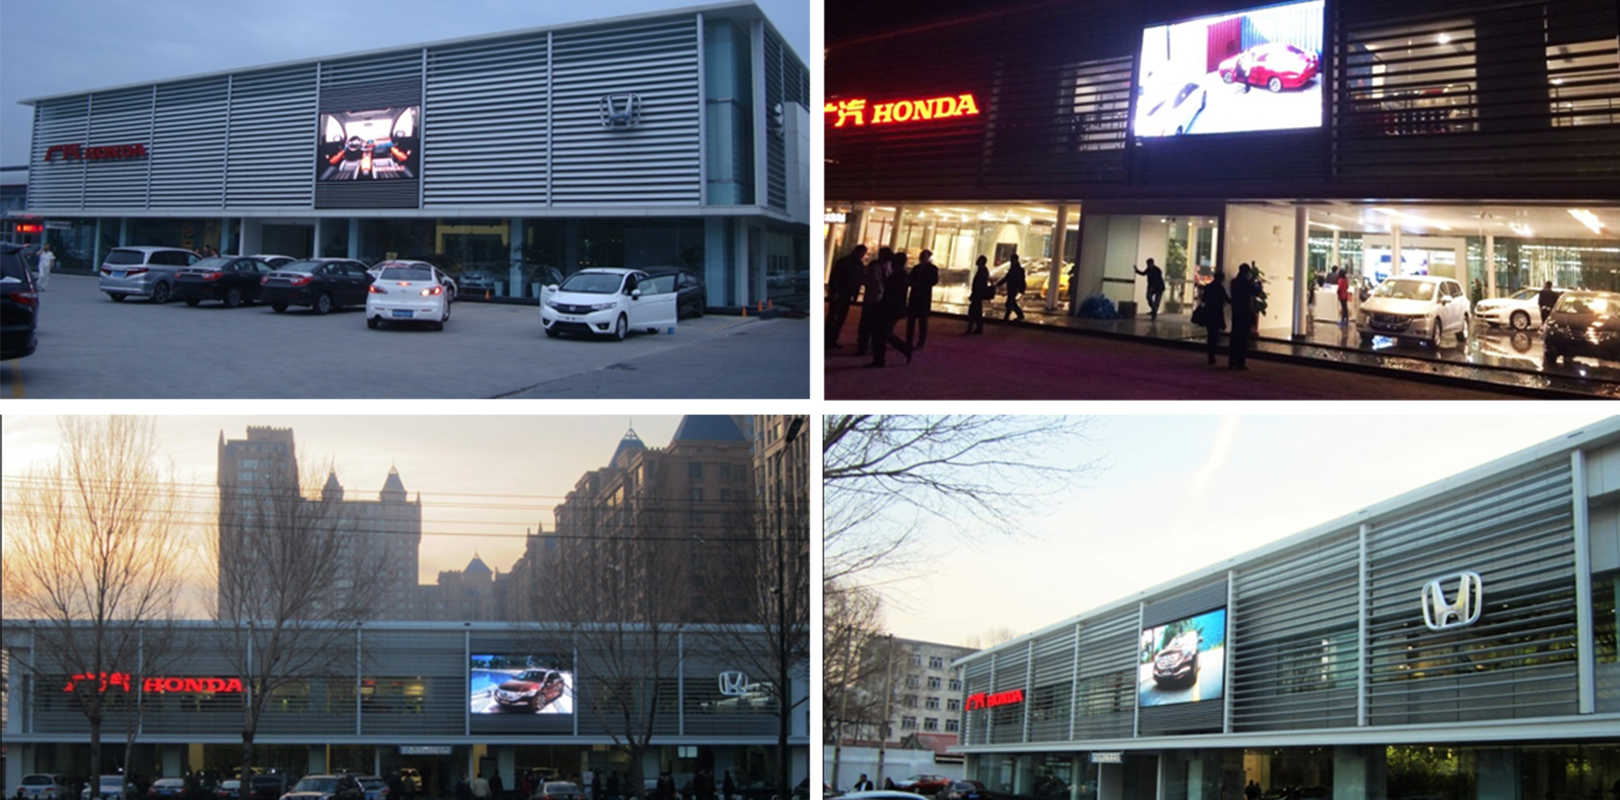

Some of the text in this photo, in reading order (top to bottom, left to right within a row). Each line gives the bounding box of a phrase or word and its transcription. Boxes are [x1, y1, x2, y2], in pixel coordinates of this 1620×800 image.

[871, 94, 979, 124] HONDA
[84, 143, 147, 160] HONDA
[142, 677, 247, 692] HONDA
